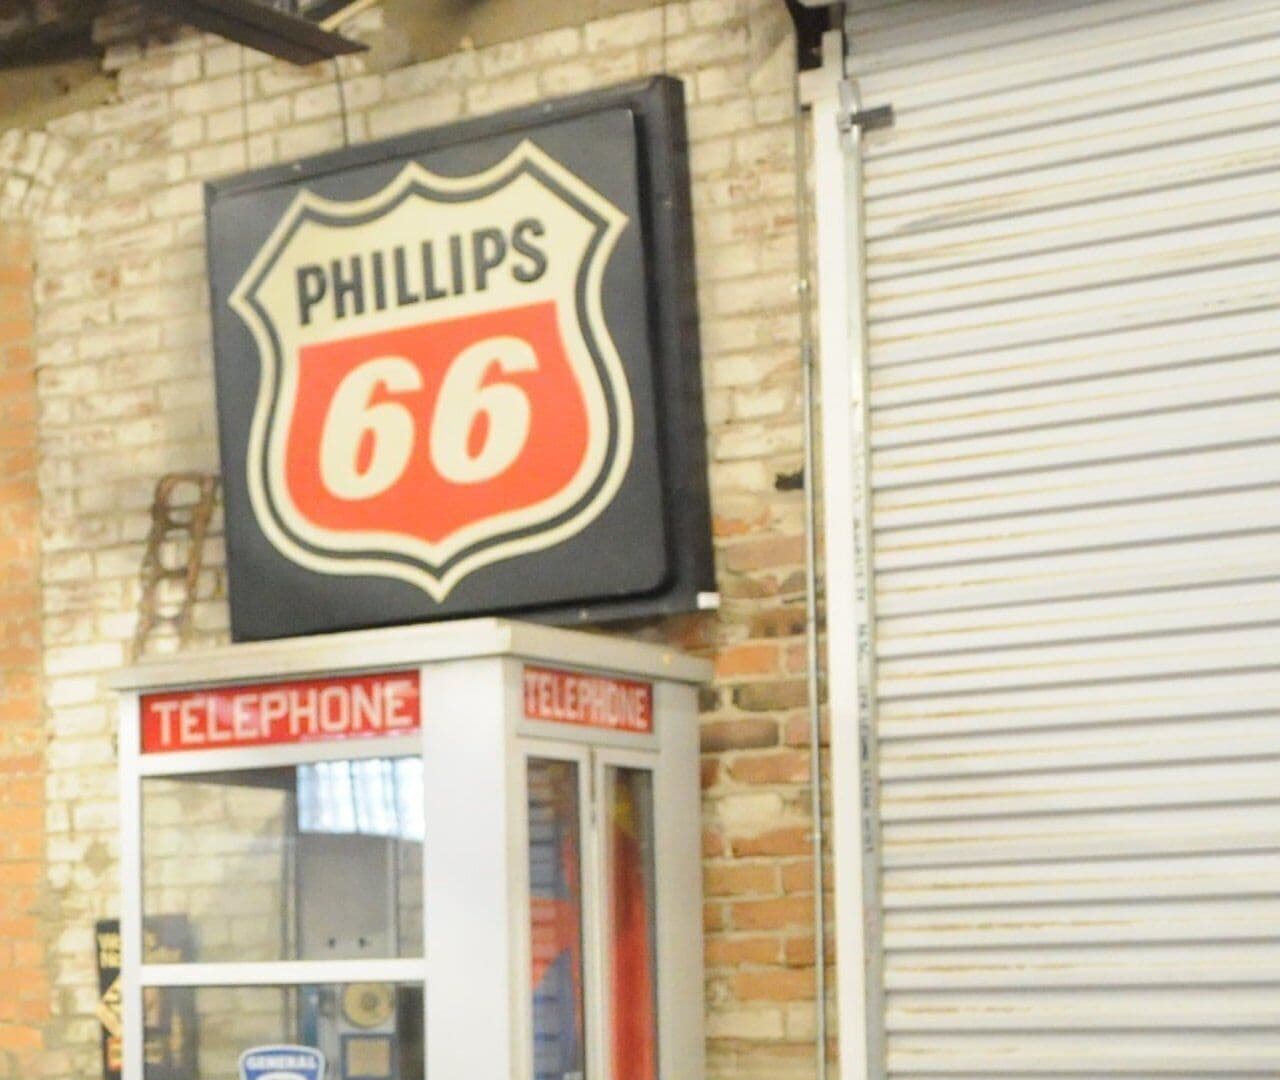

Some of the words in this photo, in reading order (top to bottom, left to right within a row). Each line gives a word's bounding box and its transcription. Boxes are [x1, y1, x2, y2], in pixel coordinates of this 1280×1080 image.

[297, 219, 547, 326] PHILLIPS
[319, 335, 539, 500] 66
[150, 680, 415, 746] TELEPHONE
[525, 671, 649, 729] TELEPHONE
